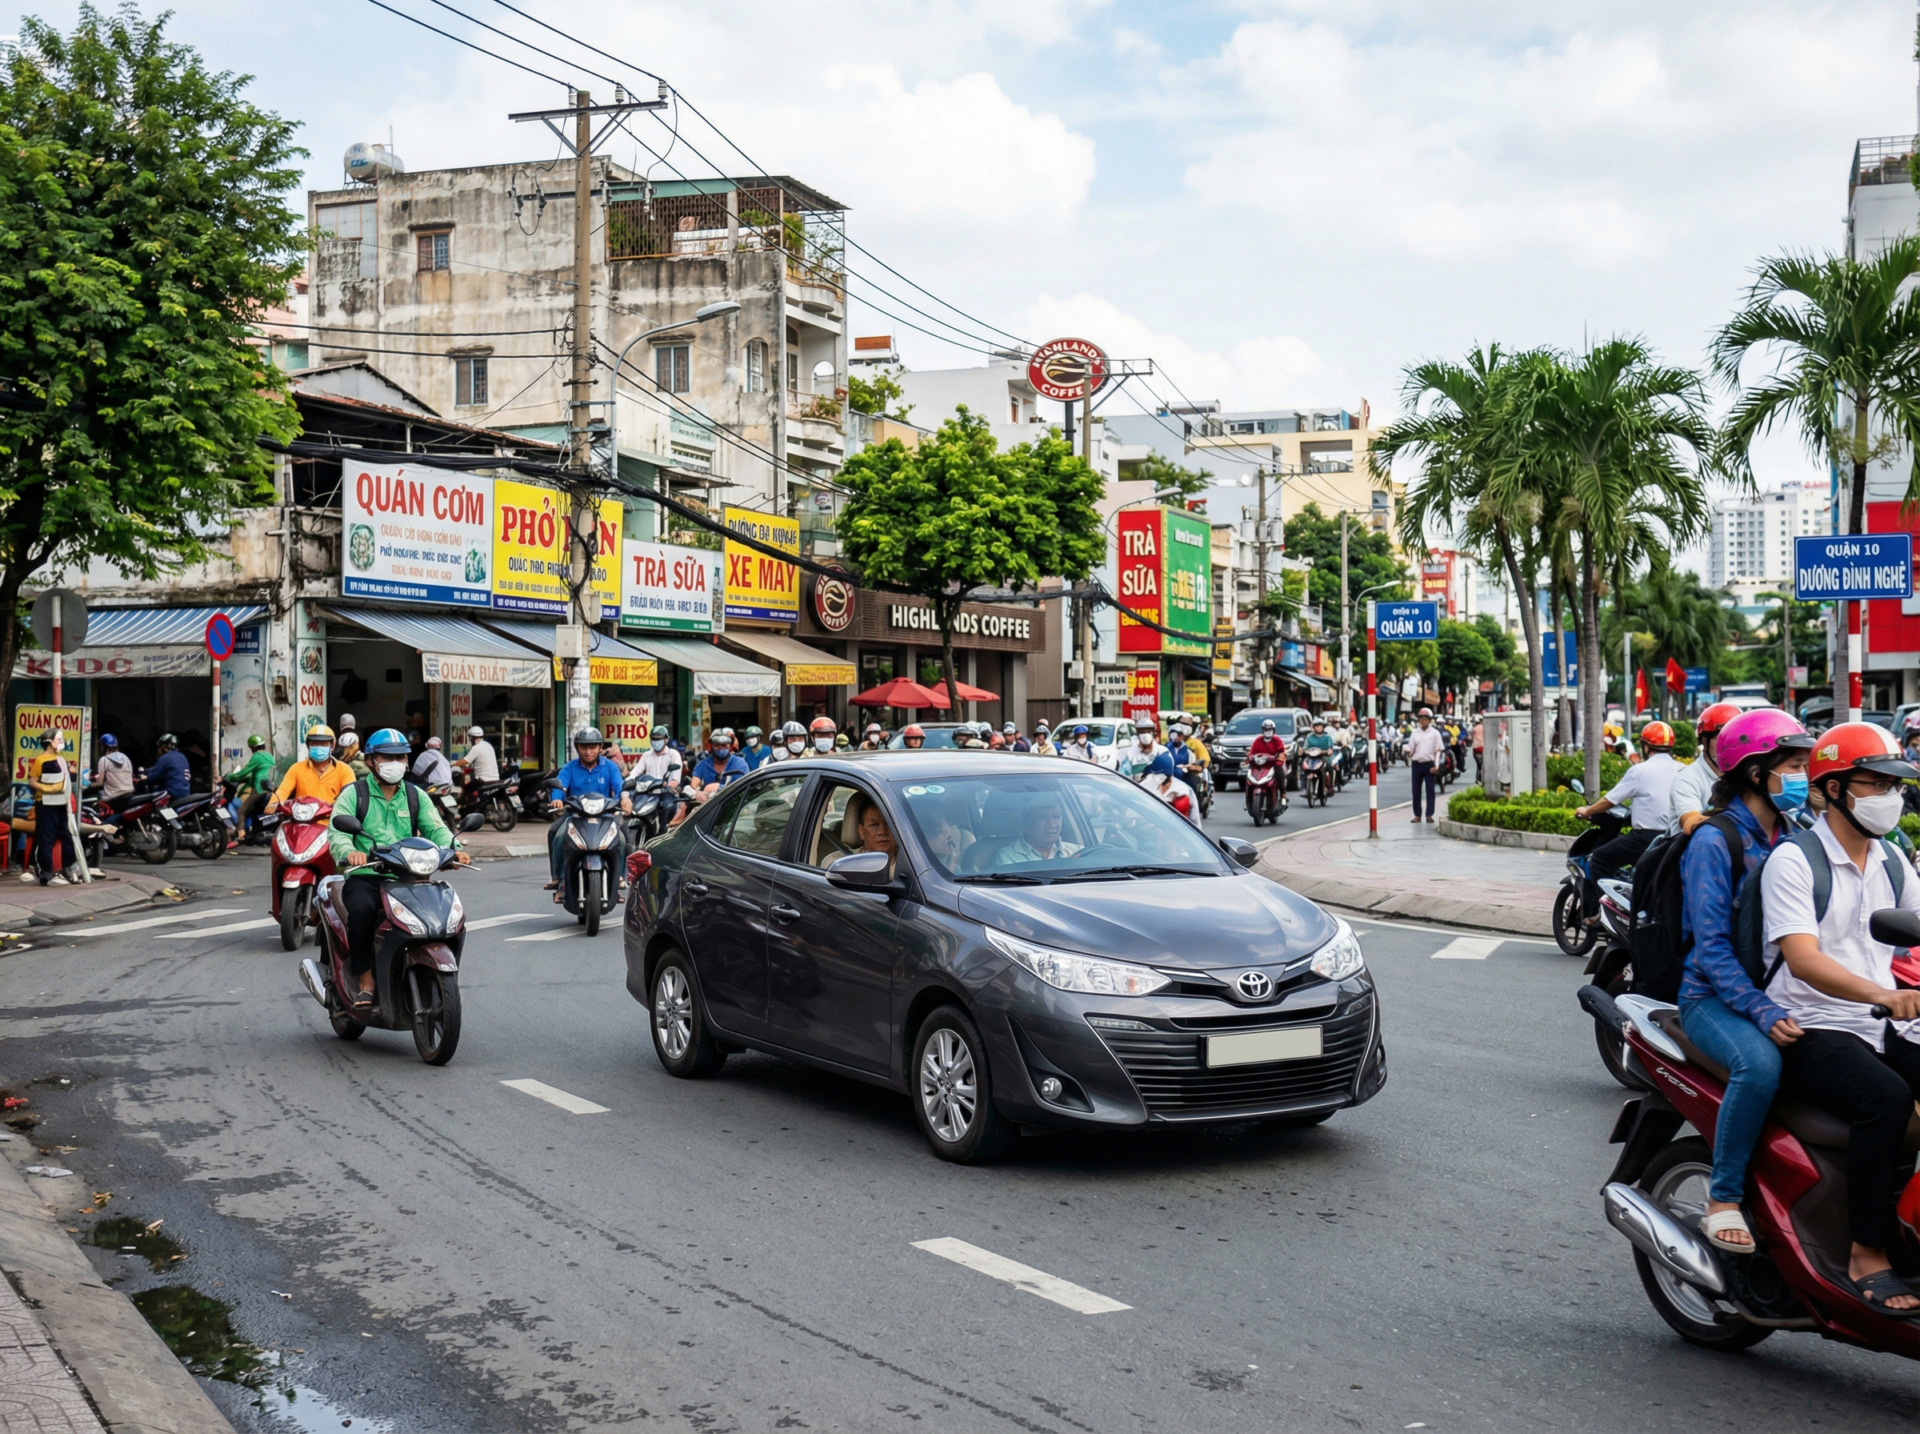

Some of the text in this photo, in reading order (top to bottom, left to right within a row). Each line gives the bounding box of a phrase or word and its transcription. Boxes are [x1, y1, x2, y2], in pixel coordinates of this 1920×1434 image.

[1041, 383, 1093, 397] COFFE
[356, 469, 485, 526] QUÁN CƠM
[500, 496, 557, 549] PHỞ
[1122, 523, 1157, 556] TRÀ
[1825, 541, 1880, 559] QUẬN 10
[633, 550, 706, 592] TRÀ SỮA
[728, 553, 752, 588] XE
[1121, 563, 1158, 596] SỮA
[891, 604, 1030, 639] HIGHLNDS COFFEE
[1380, 616, 1432, 638] QUẬN 10
